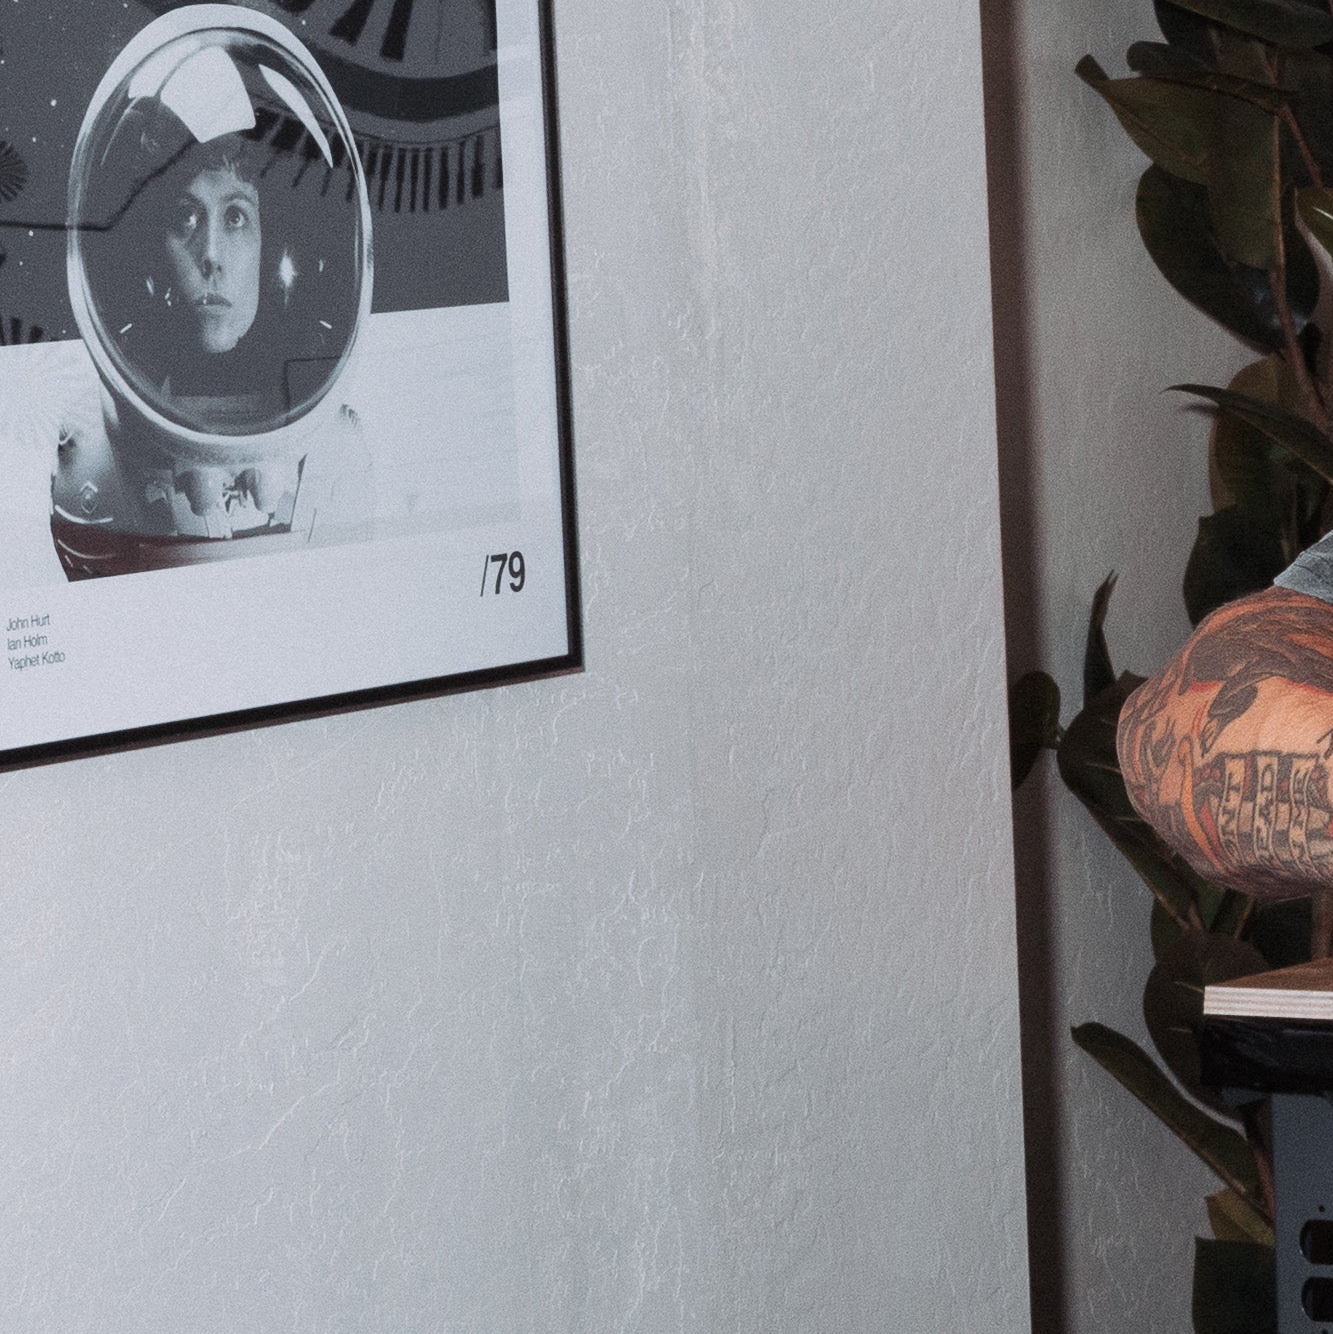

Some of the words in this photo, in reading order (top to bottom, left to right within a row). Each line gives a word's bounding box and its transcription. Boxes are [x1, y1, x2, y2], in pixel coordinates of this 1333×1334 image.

[480, 550, 526, 597] /79
[6, 617, 29, 631] John
[31, 614, 51, 627] Hurt
[8, 638, 21, 650] Ian
[24, 634, 48, 647] Holm
[8, 655, 40, 671] Yaphet
[42, 651, 66, 664] Kotto
